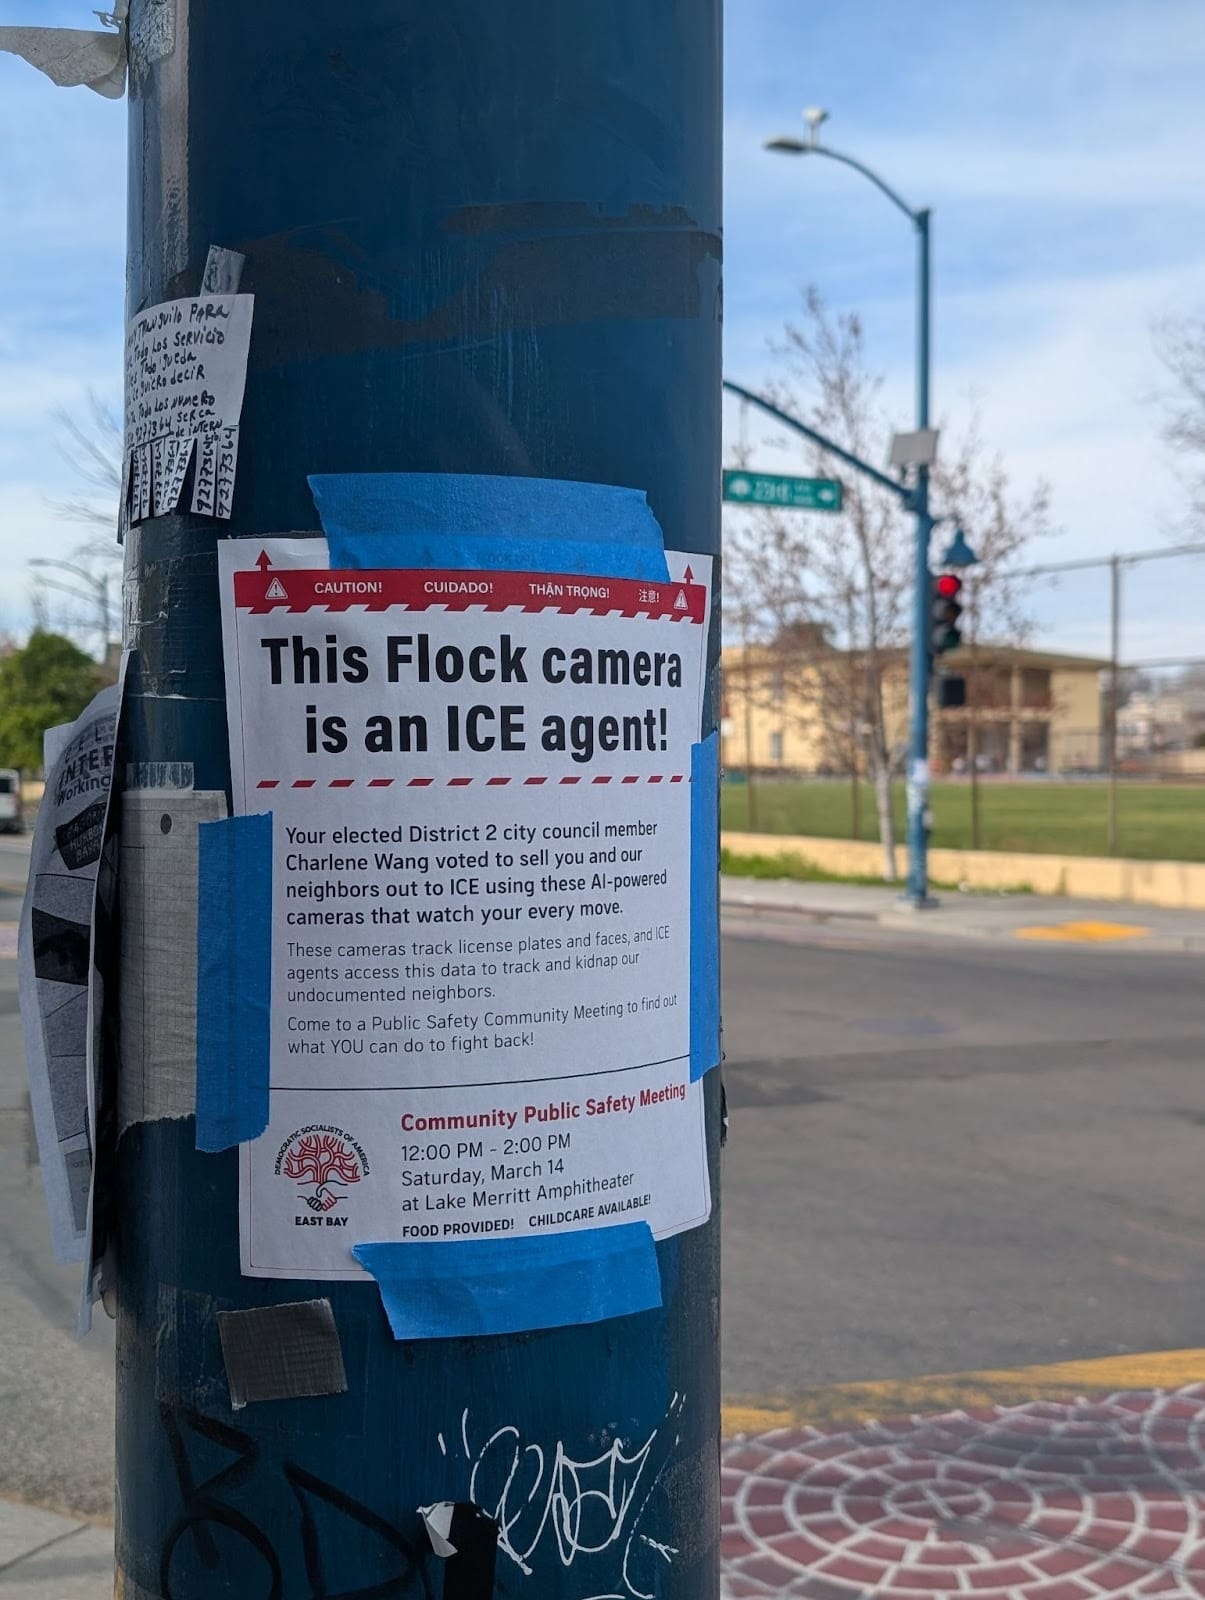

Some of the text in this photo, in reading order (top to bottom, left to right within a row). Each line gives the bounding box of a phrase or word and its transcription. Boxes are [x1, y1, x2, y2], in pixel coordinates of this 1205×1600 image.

[218, 427, 237, 517] 9277364
[314, 581, 610, 600] CAUTION! CUIDADO! THẬN TRỌNG!
[261, 634, 682, 687] This Flock camera
[306, 705, 667, 763] is an ICE agent!
[286, 820, 658, 844] Your elected District 2 city council member
[286, 847, 643, 873] Charlene Wang voted to sell you and our
[286, 869, 667, 901] neighbors out to ICE using these AI-powered
[286, 902, 623, 925] cameras that watch your every move.
[287, 926, 670, 957] These cameras track license plates and faces, and ICE
[287, 953, 640, 983] agents access this data to track and kidnap our
[287, 985, 496, 1003] undocumented neighbors.
[287, 994, 677, 1031] Come to a Public Safety Community Meeting to find out
[288, 1032, 534, 1054] what YOU can do to fight back!
[401, 1084, 686, 1132] Community Public Safety Meeting
[274, 1124, 370, 1176] DEMOCRATIC SOCIALISTS OF AMERICA
[401, 1143, 451, 1161] 12:00
[458, 1142, 483, 1158] PM
[503, 1137, 541, 1155] 2:00
[548, 1133, 571, 1150] PM
[402, 1158, 564, 1186] Saturday, March 14
[402, 1173, 634, 1211] at Lake Merritt Amphitheater
[295, 1216, 348, 1226] EAST BAY
[402, 1194, 651, 1237] FOOD PROVIDED! CHILDCARE AVAILABLE!
